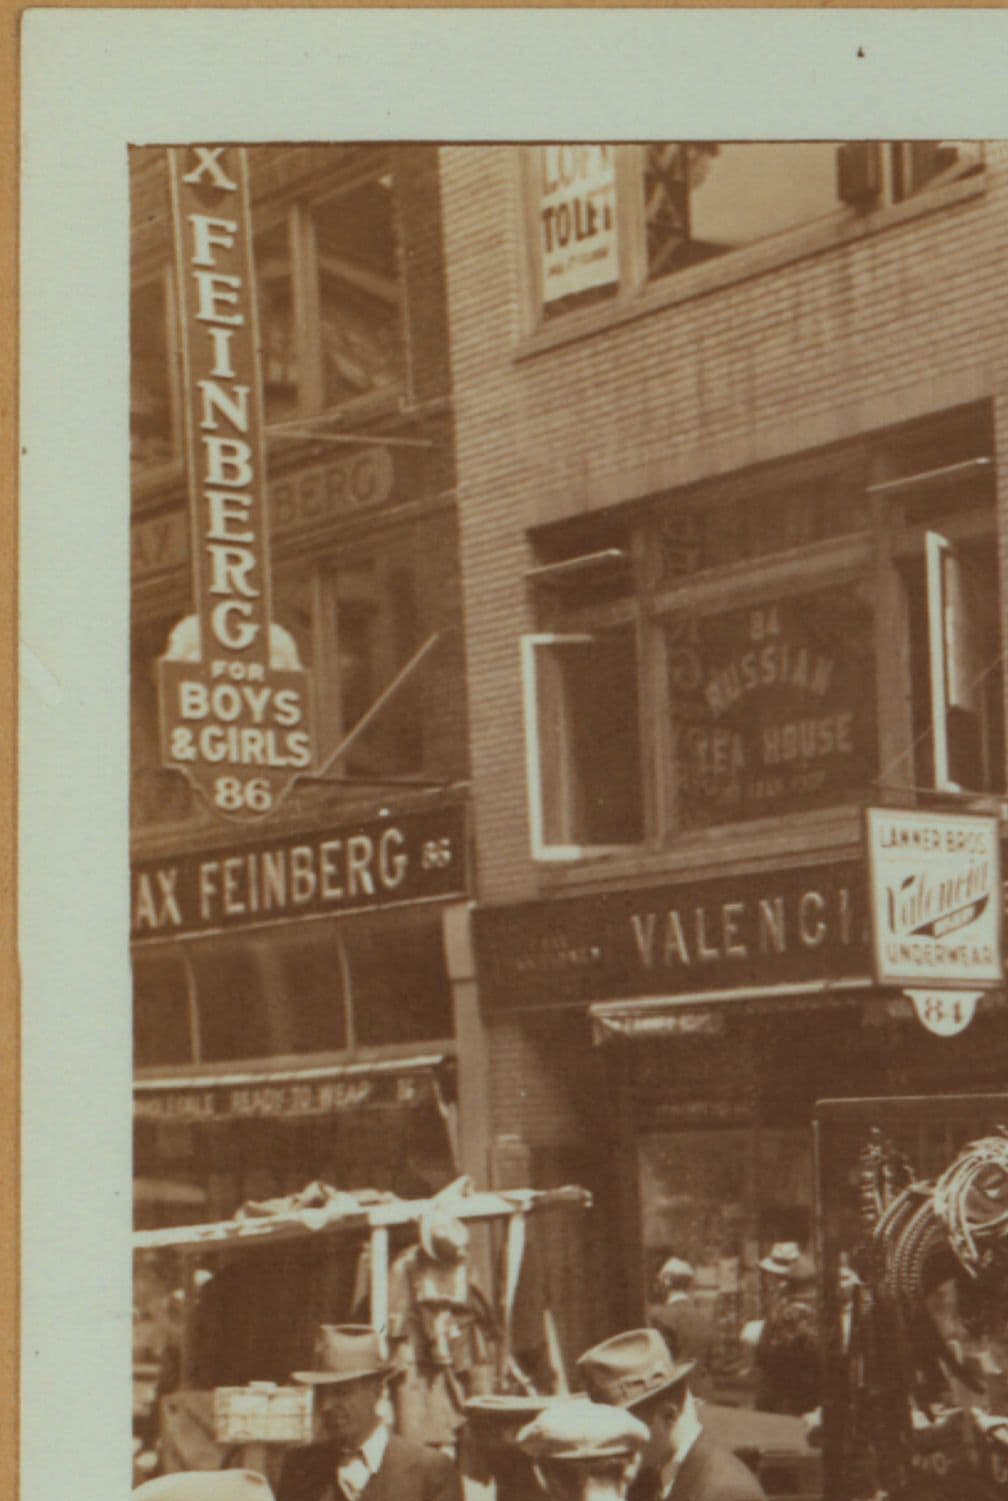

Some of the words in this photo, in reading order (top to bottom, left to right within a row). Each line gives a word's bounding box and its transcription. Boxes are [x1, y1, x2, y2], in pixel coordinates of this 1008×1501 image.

[189, 213, 259, 649] FEINBERG
[211, 660, 264, 681] FOR
[179, 681, 302, 726] BOYS
[762, 711, 854, 767] HOUSE
[214, 777, 272, 811] 86
[200, 828, 408, 920] FEINBERG
[629, 888, 870, 970] VALENCI
